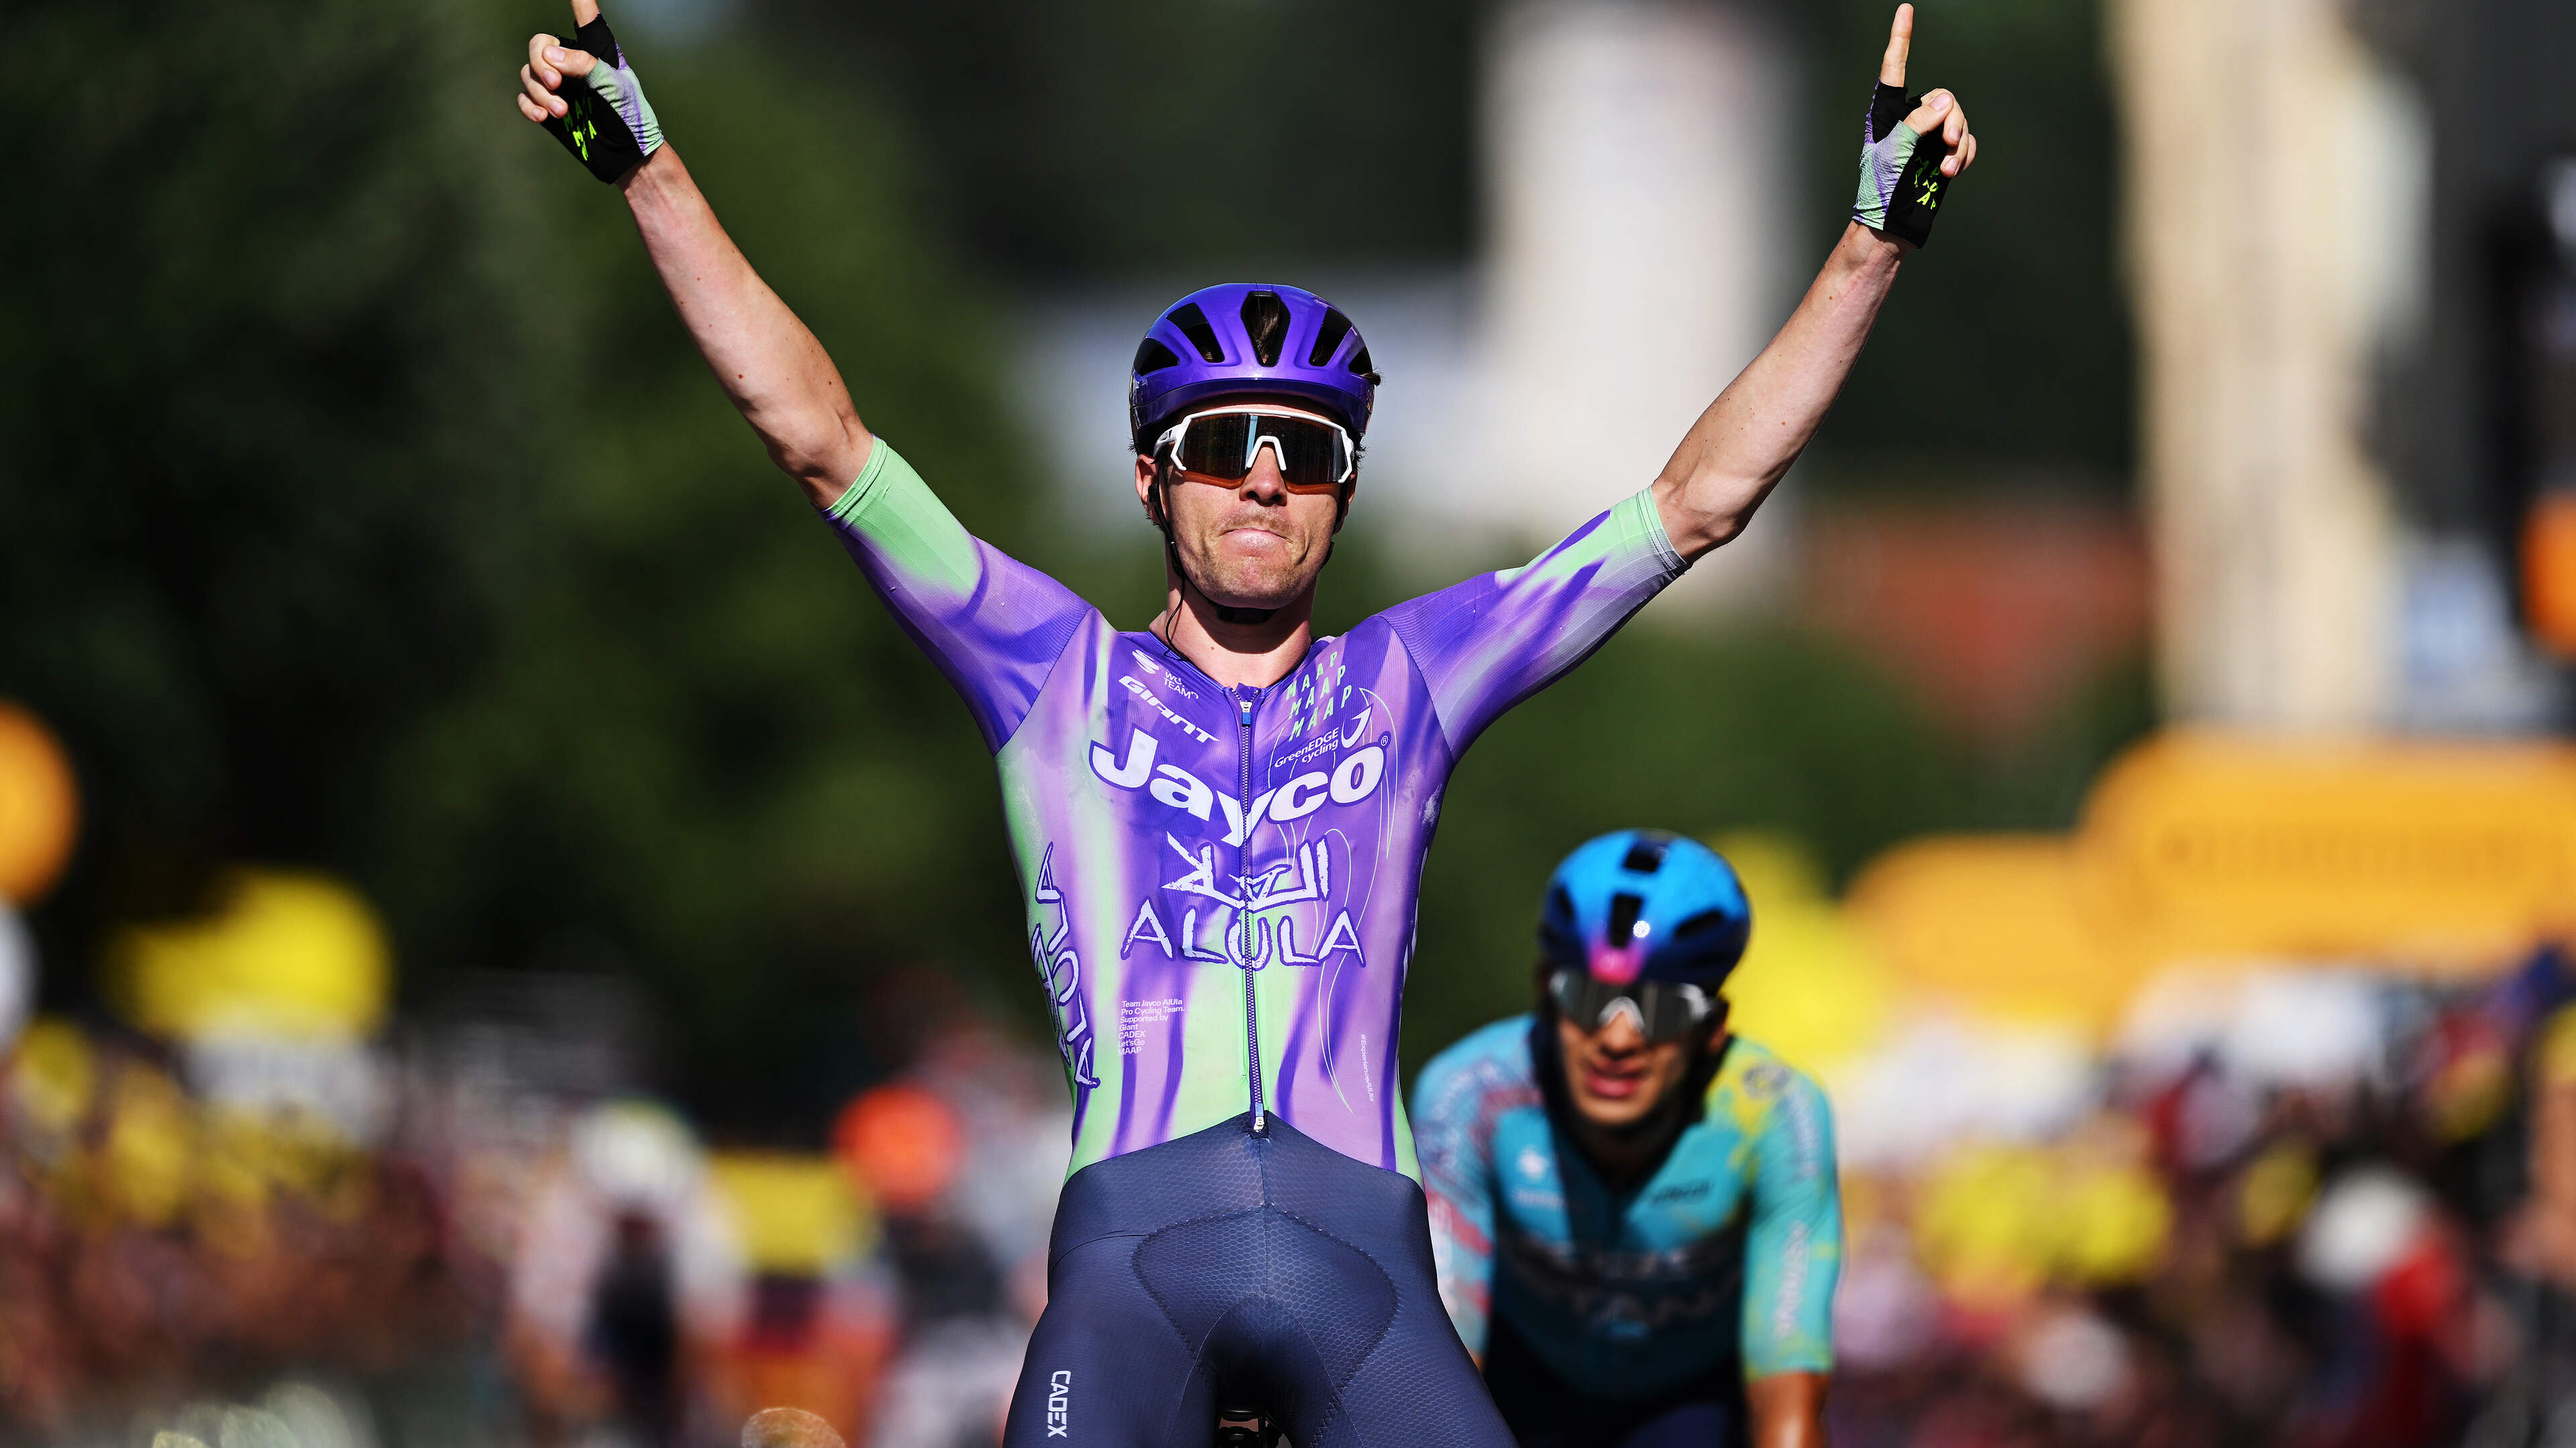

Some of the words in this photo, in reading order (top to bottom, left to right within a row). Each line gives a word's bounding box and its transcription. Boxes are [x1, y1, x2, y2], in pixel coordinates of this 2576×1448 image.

[1286, 651, 1338, 702] MAAP
[1288, 664, 1346, 720] MAAP
[1289, 685, 1352, 742] MAAP
[1274, 727, 1340, 768] GreenEDGE
[1301, 739, 1339, 763] cycling
[1134, 1007, 1162, 1015] Cycling
[1142, 999, 1161, 1007] Jayco
[1119, 1023, 1138, 1032] Giant
[1120, 1015, 1158, 1024] Supported
[1118, 1030, 1146, 1040] CADEX
[1118, 1046, 1142, 1056] MAAP
[1047, 1370, 1071, 1438] CADEX
